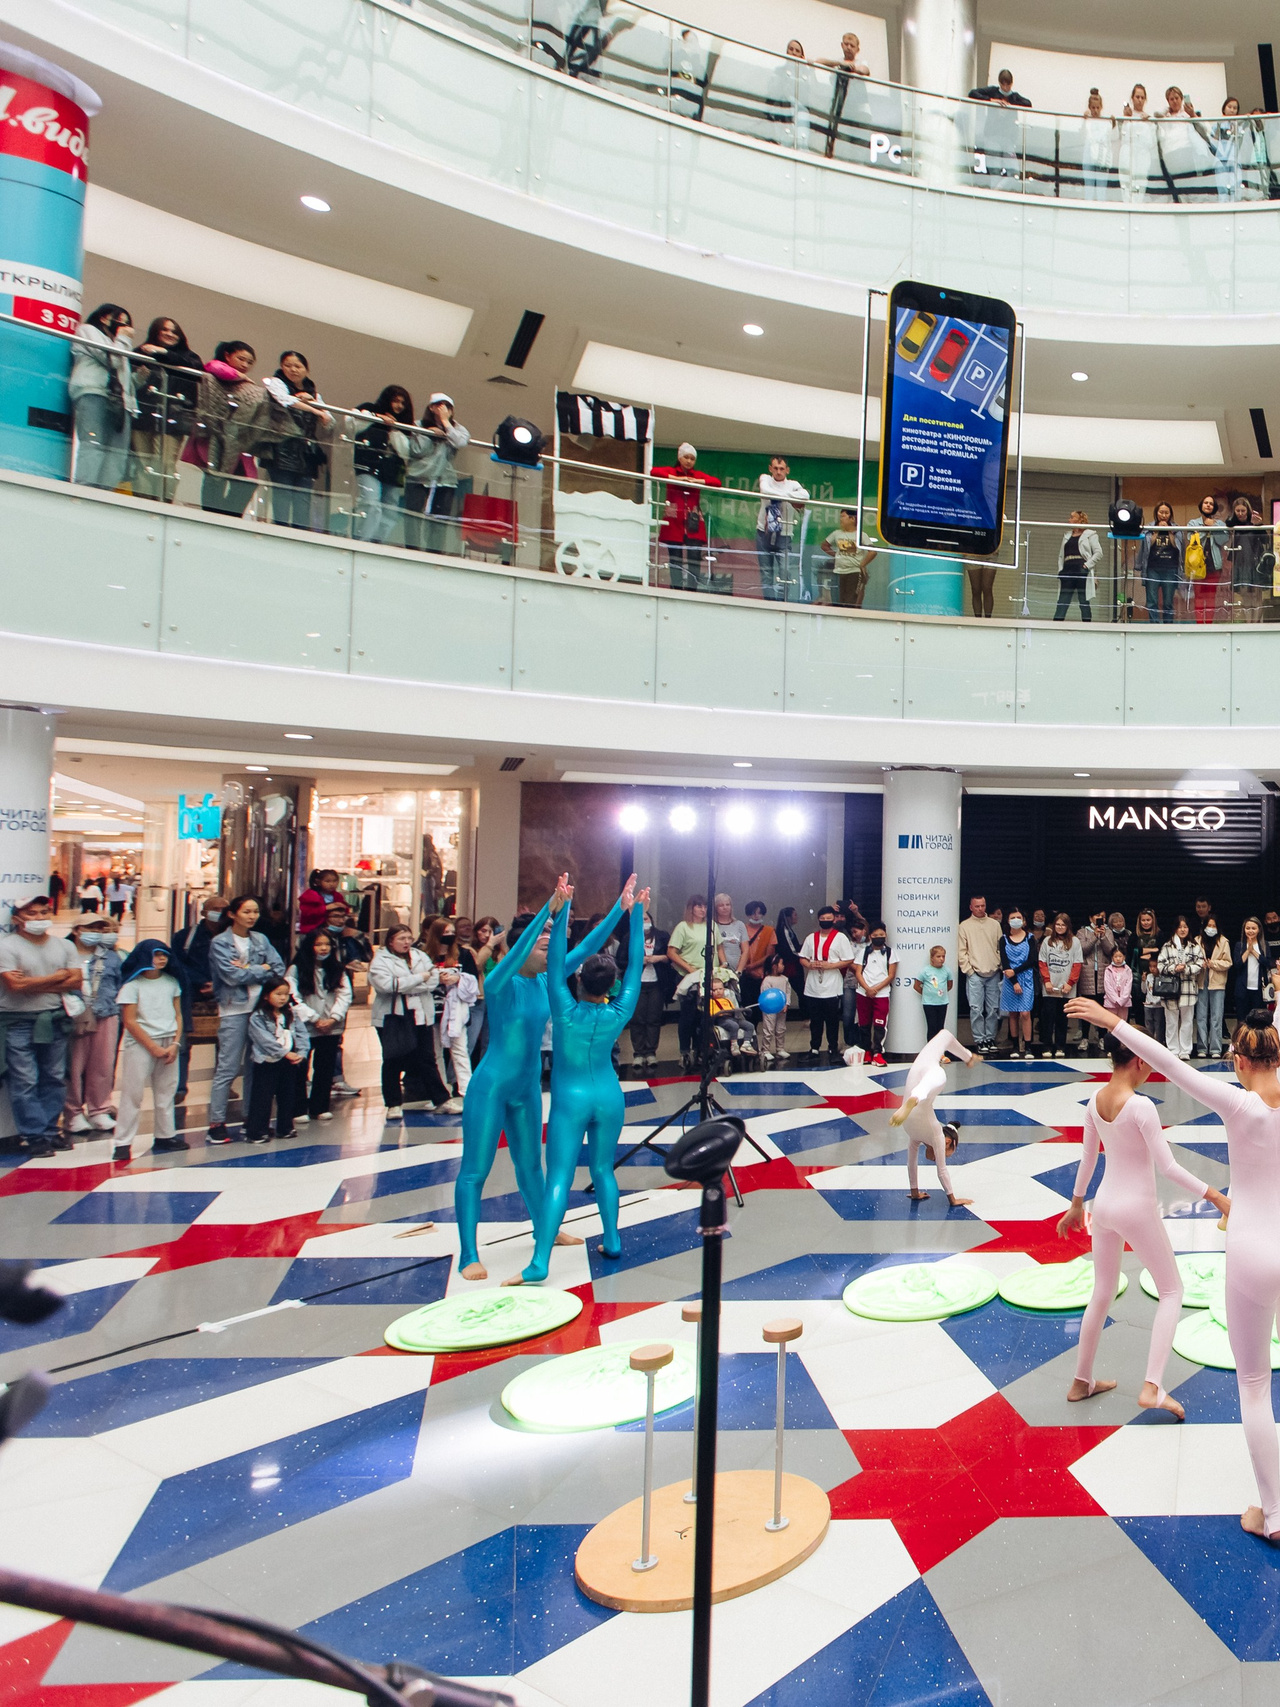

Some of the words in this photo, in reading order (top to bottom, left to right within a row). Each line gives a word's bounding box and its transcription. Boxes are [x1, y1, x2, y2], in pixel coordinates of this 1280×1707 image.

[40, 308, 54, 324] 3
[903, 413, 918, 422] Для
[919, 417, 964, 430] посетителей
[902, 427, 942, 439] кинотеатра
[902, 435, 938, 446] ресторана
[901, 443, 938, 454] автомойки
[929, 465, 935, 473] 3
[936, 467, 952, 476] часа
[928, 474, 962, 485] парковки
[928, 481, 965, 493] бесплатно
[1089, 805, 1226, 831] MANGO
[925, 833, 953, 842] ЧИТАЙ
[925, 842, 953, 850] ГОРОД
[897, 876, 953, 885] БЕСТСЕЛЛЕРЫ
[897, 893, 940, 901] НОВИНКИ
[897, 910, 938, 918] ПОДАРКИ
[896, 926, 951, 935] КАНЦЕЛЯРИЯ
[895, 977, 901, 987] 3
